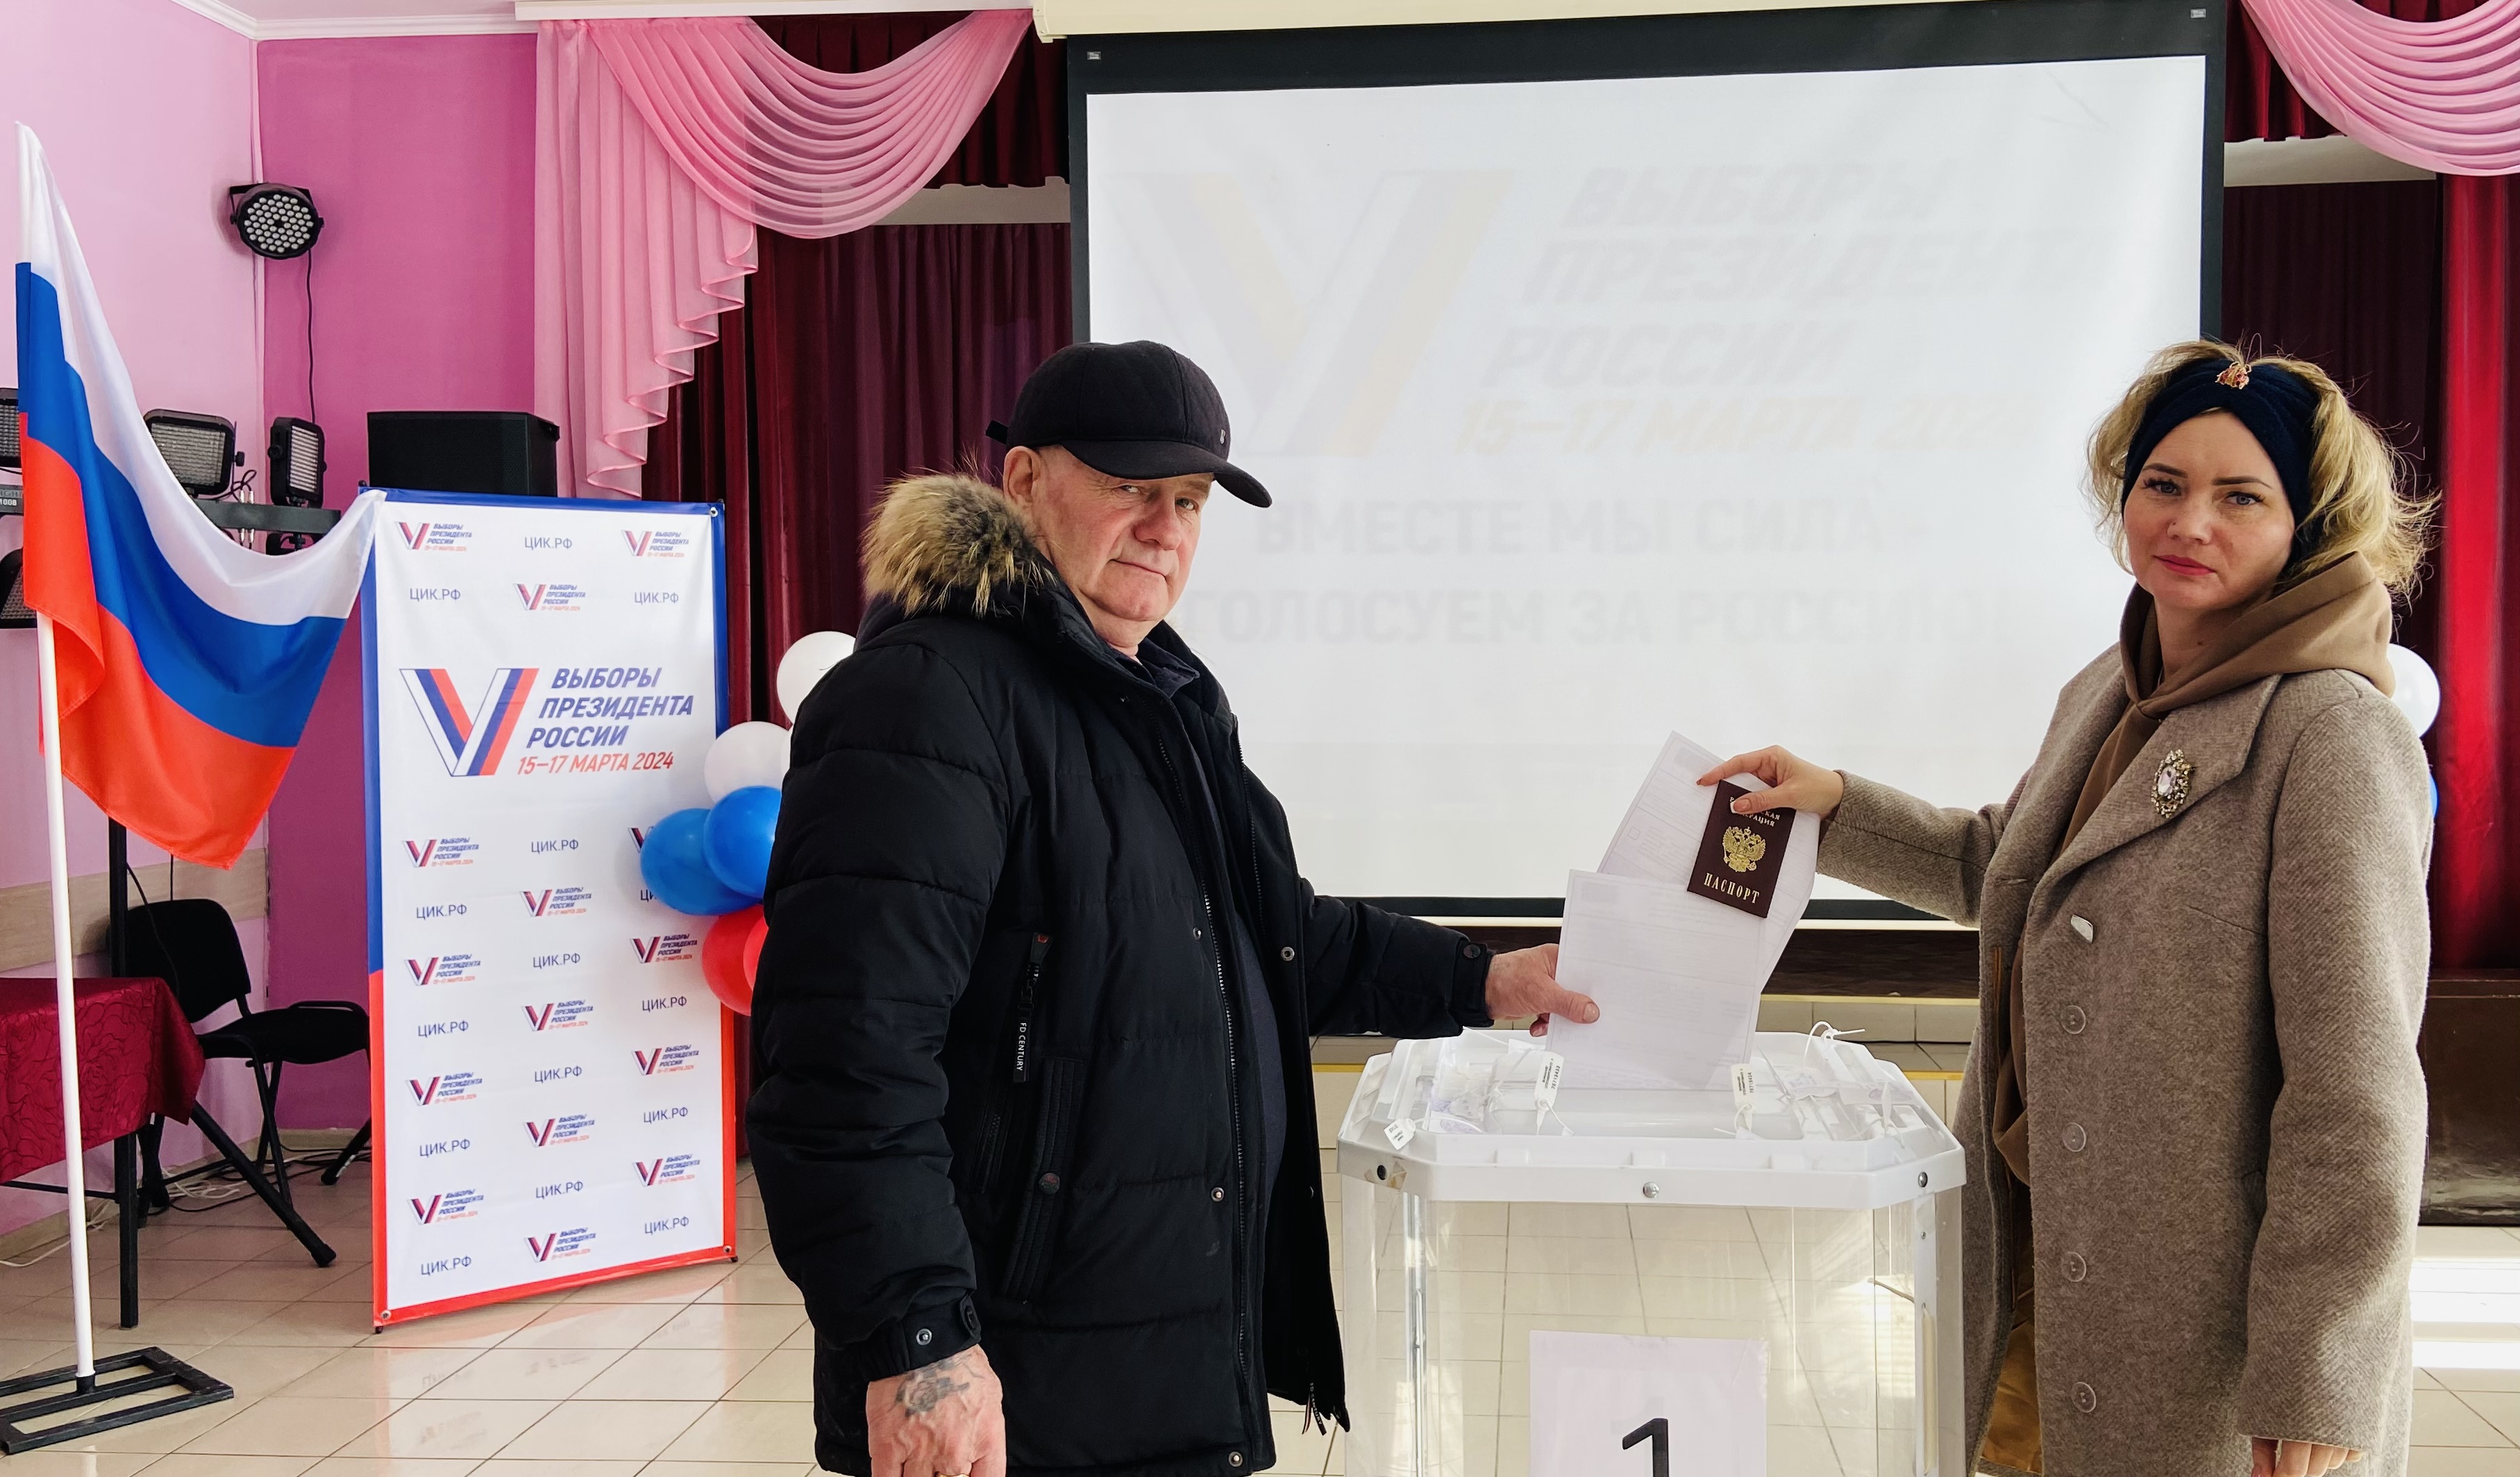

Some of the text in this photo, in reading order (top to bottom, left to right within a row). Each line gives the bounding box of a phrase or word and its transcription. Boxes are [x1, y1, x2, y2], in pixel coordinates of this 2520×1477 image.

[1255, 498, 1524, 555] ВМЕСТЕ
[1549, 498, 1670, 554] МЫ
[525, 537, 572, 550] ЦИК.РФ
[410, 589, 460, 601] ЦИК.РФ
[635, 592, 678, 605] ЦИК.РФ
[1568, 589, 1654, 644] ЗА
[551, 667, 662, 689] ВЫБОРЫ
[538, 695, 694, 720] ПРЕЗИДЕНТА
[526, 725, 630, 748] РОССИИ
[569, 753, 629, 773] МАРТА
[632, 751, 674, 770] 2024
[531, 839, 579, 854] ЦИК.РФ
[1703, 872, 1760, 904] ПАСПОРТ
[417, 904, 467, 920] ЦИК.РФ
[533, 953, 580, 969] ЦИК.РФ
[642, 996, 687, 1012] ЦИК.РФ
[418, 1020, 469, 1038] ЦИК.РФ
[1016, 1022, 1027, 1071] FD CENTURY
[535, 1065, 582, 1083] ЦИК.РФ
[644, 1107, 688, 1124] ЦИК.РФ
[419, 1138, 470, 1158] ЦИК.РФ
[536, 1181, 583, 1199] ЦИК.РФ
[645, 1217, 689, 1235] ЦИК.РФ
[421, 1256, 471, 1276] ЦИК.РФ
[1622, 1418, 1669, 1477] 1
